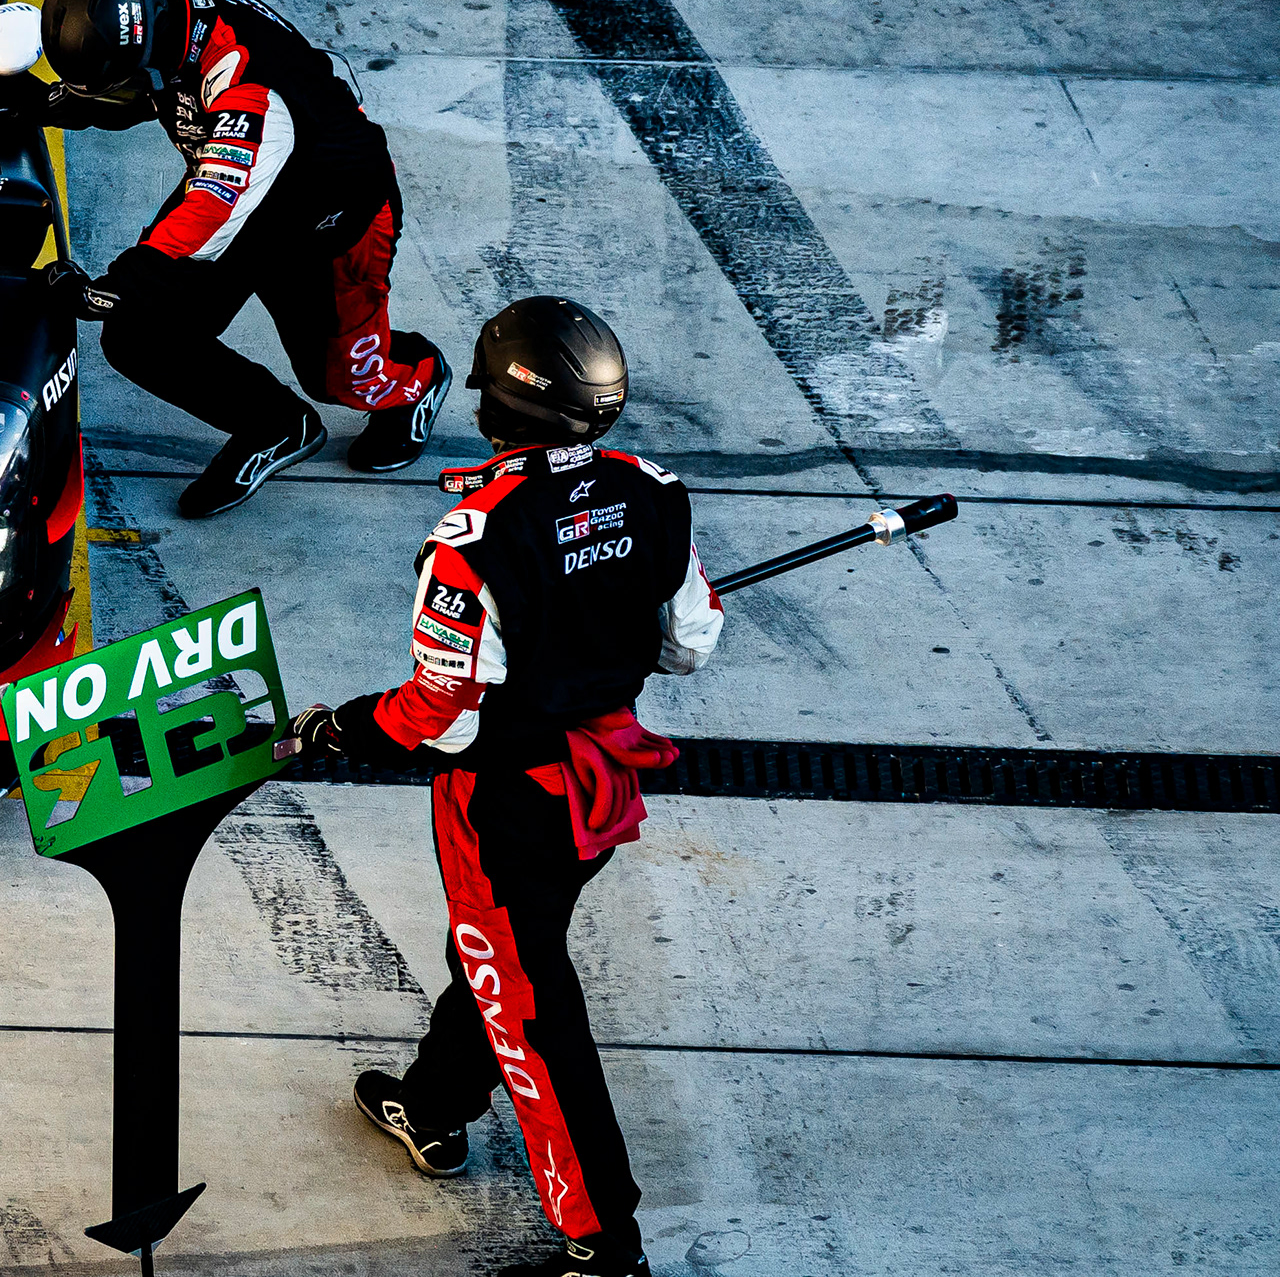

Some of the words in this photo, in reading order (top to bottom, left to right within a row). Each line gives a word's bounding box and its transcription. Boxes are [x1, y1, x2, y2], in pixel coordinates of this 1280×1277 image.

[118, 2, 130, 46] uvex
[194, 181, 233, 200] MICHELIN
[42, 347, 78, 412] AISIN
[590, 502, 627, 517] TOYOTA
[590, 511, 624, 525] GAZOO
[560, 521, 589, 542] GR
[565, 536, 633, 575] DENSO
[432, 585, 466, 613] 24h
[127, 600, 257, 702] DRV
[421, 667, 463, 692] WEC
[15, 662, 108, 744] ON
[454, 922, 541, 1101] DENSO
